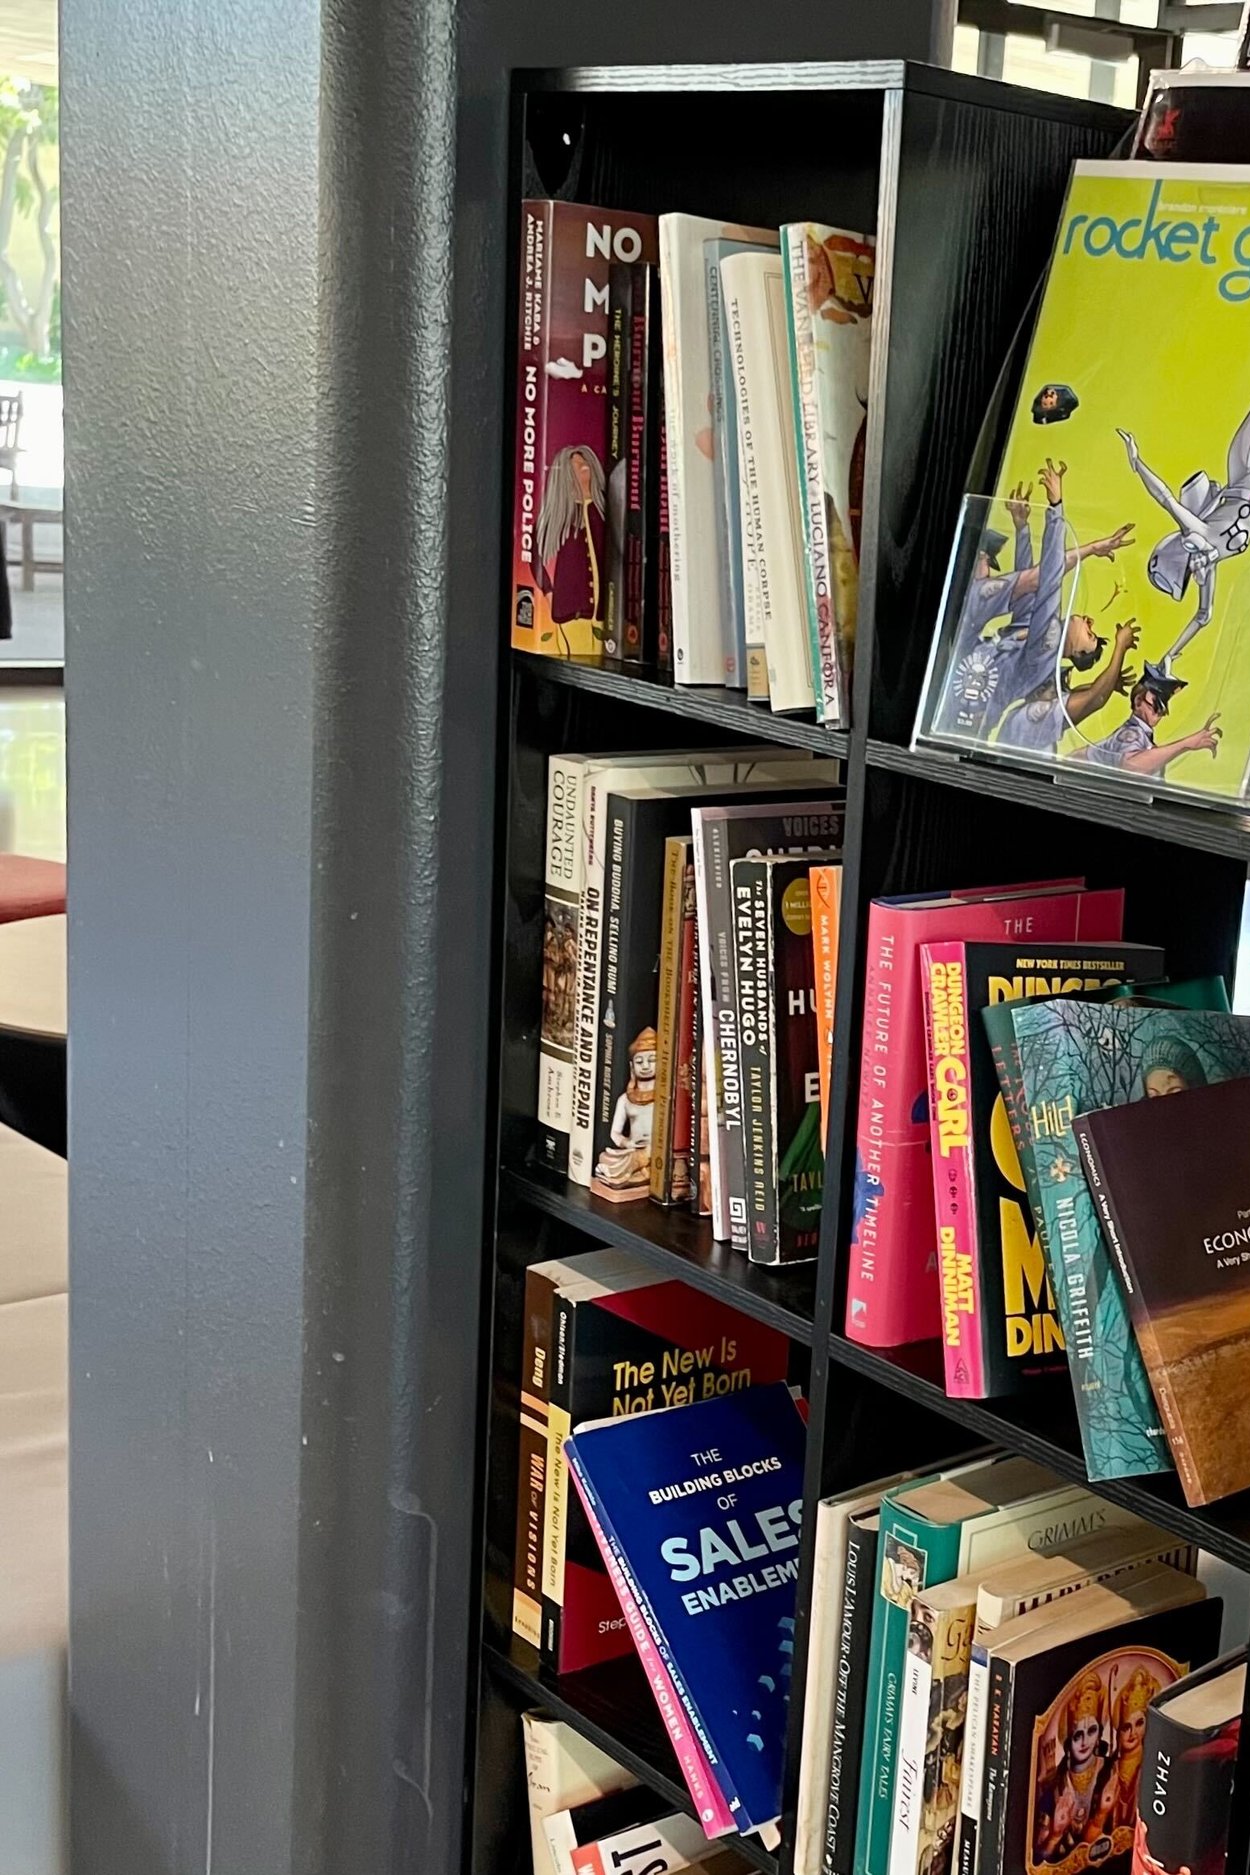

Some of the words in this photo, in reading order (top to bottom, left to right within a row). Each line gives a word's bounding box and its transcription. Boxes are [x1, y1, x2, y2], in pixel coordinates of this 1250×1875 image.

[585, 222, 642, 263] NO
[1063, 179, 1220, 265] rocket
[525, 366, 537, 401] NO
[731, 298, 750, 426] TECHNOLOGIES
[523, 407, 536, 474] MORE
[746, 431, 754, 448] OF
[748, 455, 758, 489] THE
[521, 479, 534, 564] POLICE
[752, 494, 764, 552] HUMAN
[811, 500, 828, 597] LUCIANO
[760, 559, 773, 620] CORPSE
[550, 770, 565, 878] COURAGE
[564, 774, 577, 880] UNDAUNTED
[612, 819, 624, 862] BUYING
[585, 886, 600, 912] ON
[736, 886, 754, 971] EVELYN
[754, 900, 767, 951] SEVEN
[581, 914, 598, 1025] REPENTANCE
[606, 965, 618, 995] RUMI
[880, 935, 895, 970] THE
[1016, 958, 1034, 969] NEW
[1036, 958, 1058, 970] YORK
[740, 980, 757, 1046] HUGO
[755, 958, 768, 1042] HUSBANDS
[875, 981, 891, 1054] FUTURE
[930, 962, 951, 1057] CRAWLER
[946, 962, 966, 1055] DUNGEON
[579, 1028, 594, 1068] AND
[718, 1009, 742, 1131] CHERNOBYL
[873, 1065, 887, 1089] OF
[576, 1071, 592, 1130] REPAIR
[935, 1056, 969, 1158] CARL
[866, 1098, 885, 1186] ANOTHER
[860, 1197, 879, 1283] TIMELINE
[1056, 1197, 1080, 1265] NICOLA
[940, 1227, 961, 1347] DINNIMAN
[956, 1253, 974, 1314] MATT
[1067, 1273, 1094, 1360] GRIFFITH
[532, 1347, 546, 1388] Deng
[613, 1361, 655, 1392] The
[662, 1346, 714, 1379] New
[721, 1336, 737, 1363] Is
[530, 1453, 545, 1492] WAR
[649, 1473, 723, 1505] BUILDING
[723, 1456, 782, 1483] BLOCKS
[690, 1449, 723, 1467] THE
[716, 1493, 738, 1511] OF
[526, 1510, 539, 1590] VISIONS
[1153, 1751, 1171, 1817] ZHAO
